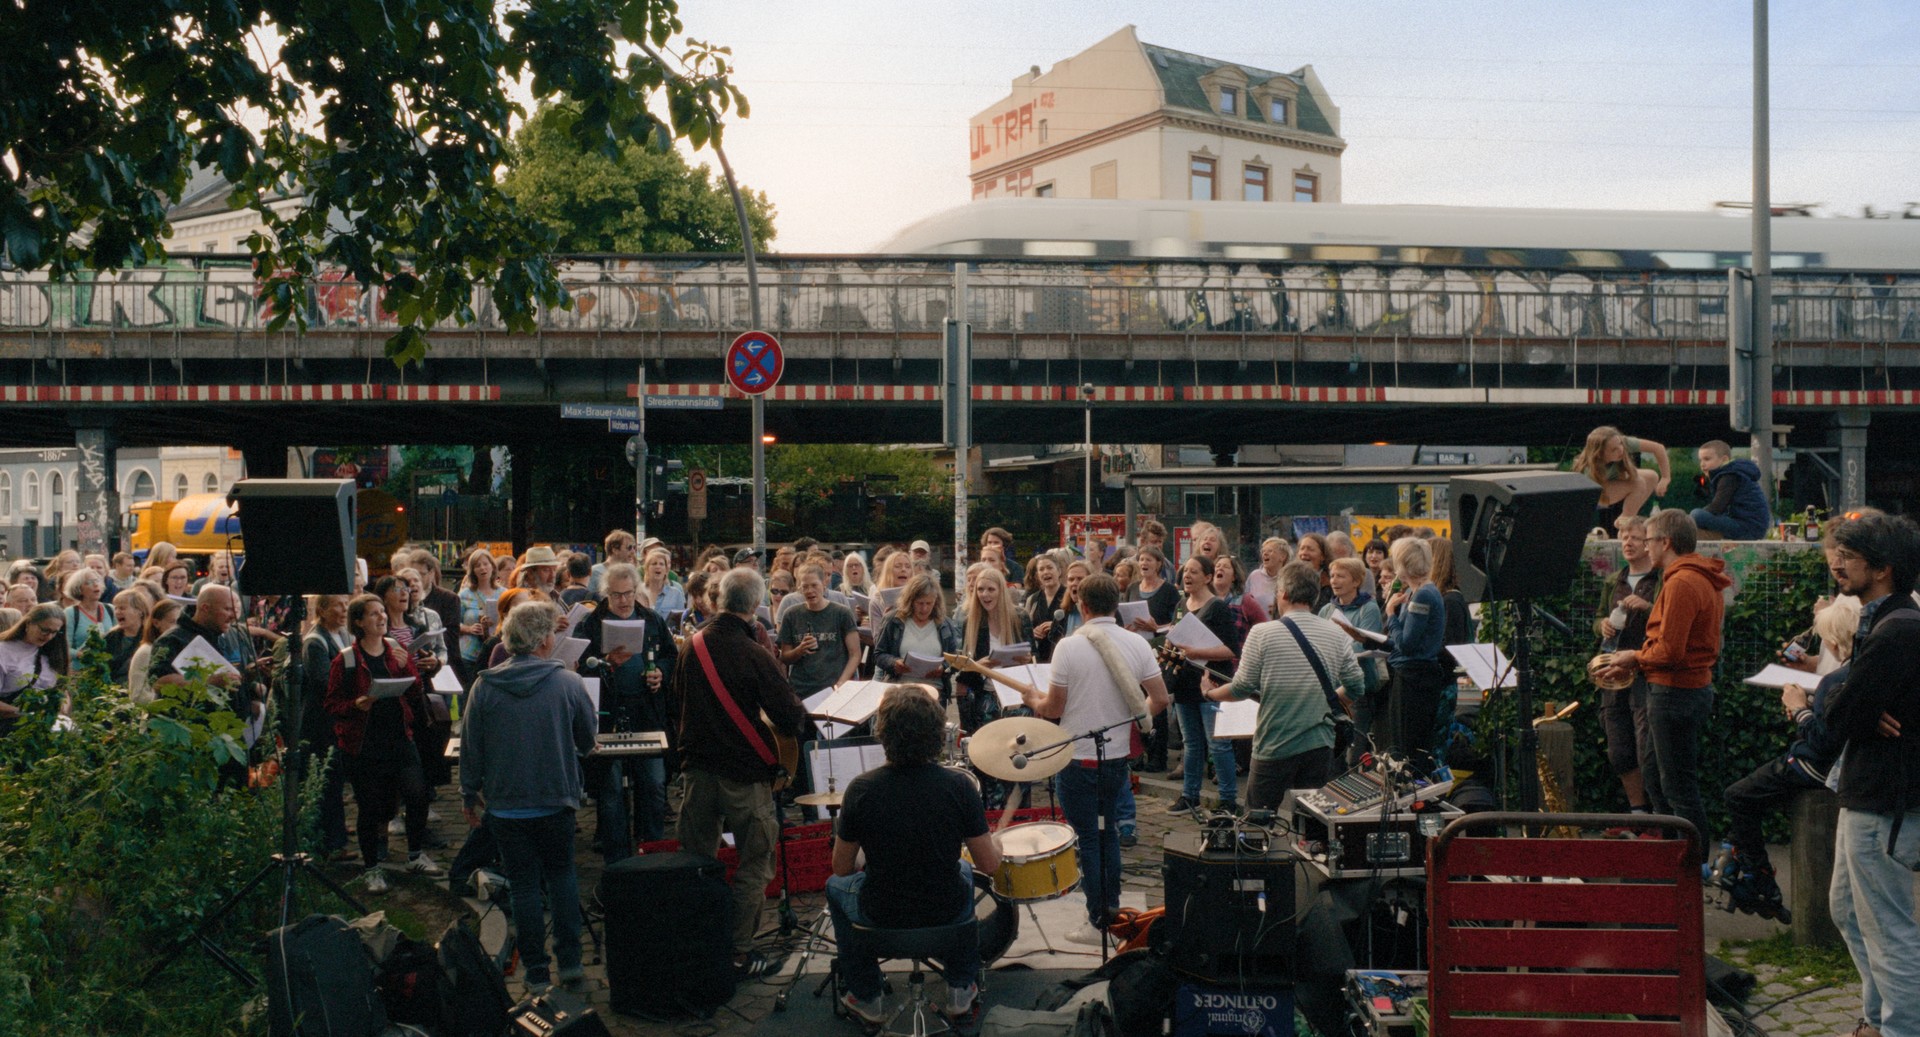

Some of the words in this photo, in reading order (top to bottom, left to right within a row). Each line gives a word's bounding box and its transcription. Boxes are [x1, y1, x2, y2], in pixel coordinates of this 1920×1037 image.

[647, 396, 720, 407] Stresemannstraße
[564, 406, 637, 418] Max-Brauer-Allee
[43, 450, 61, 462] 1867
[1439, 453, 1455, 462] BAR
[361, 523, 396, 539] JET
